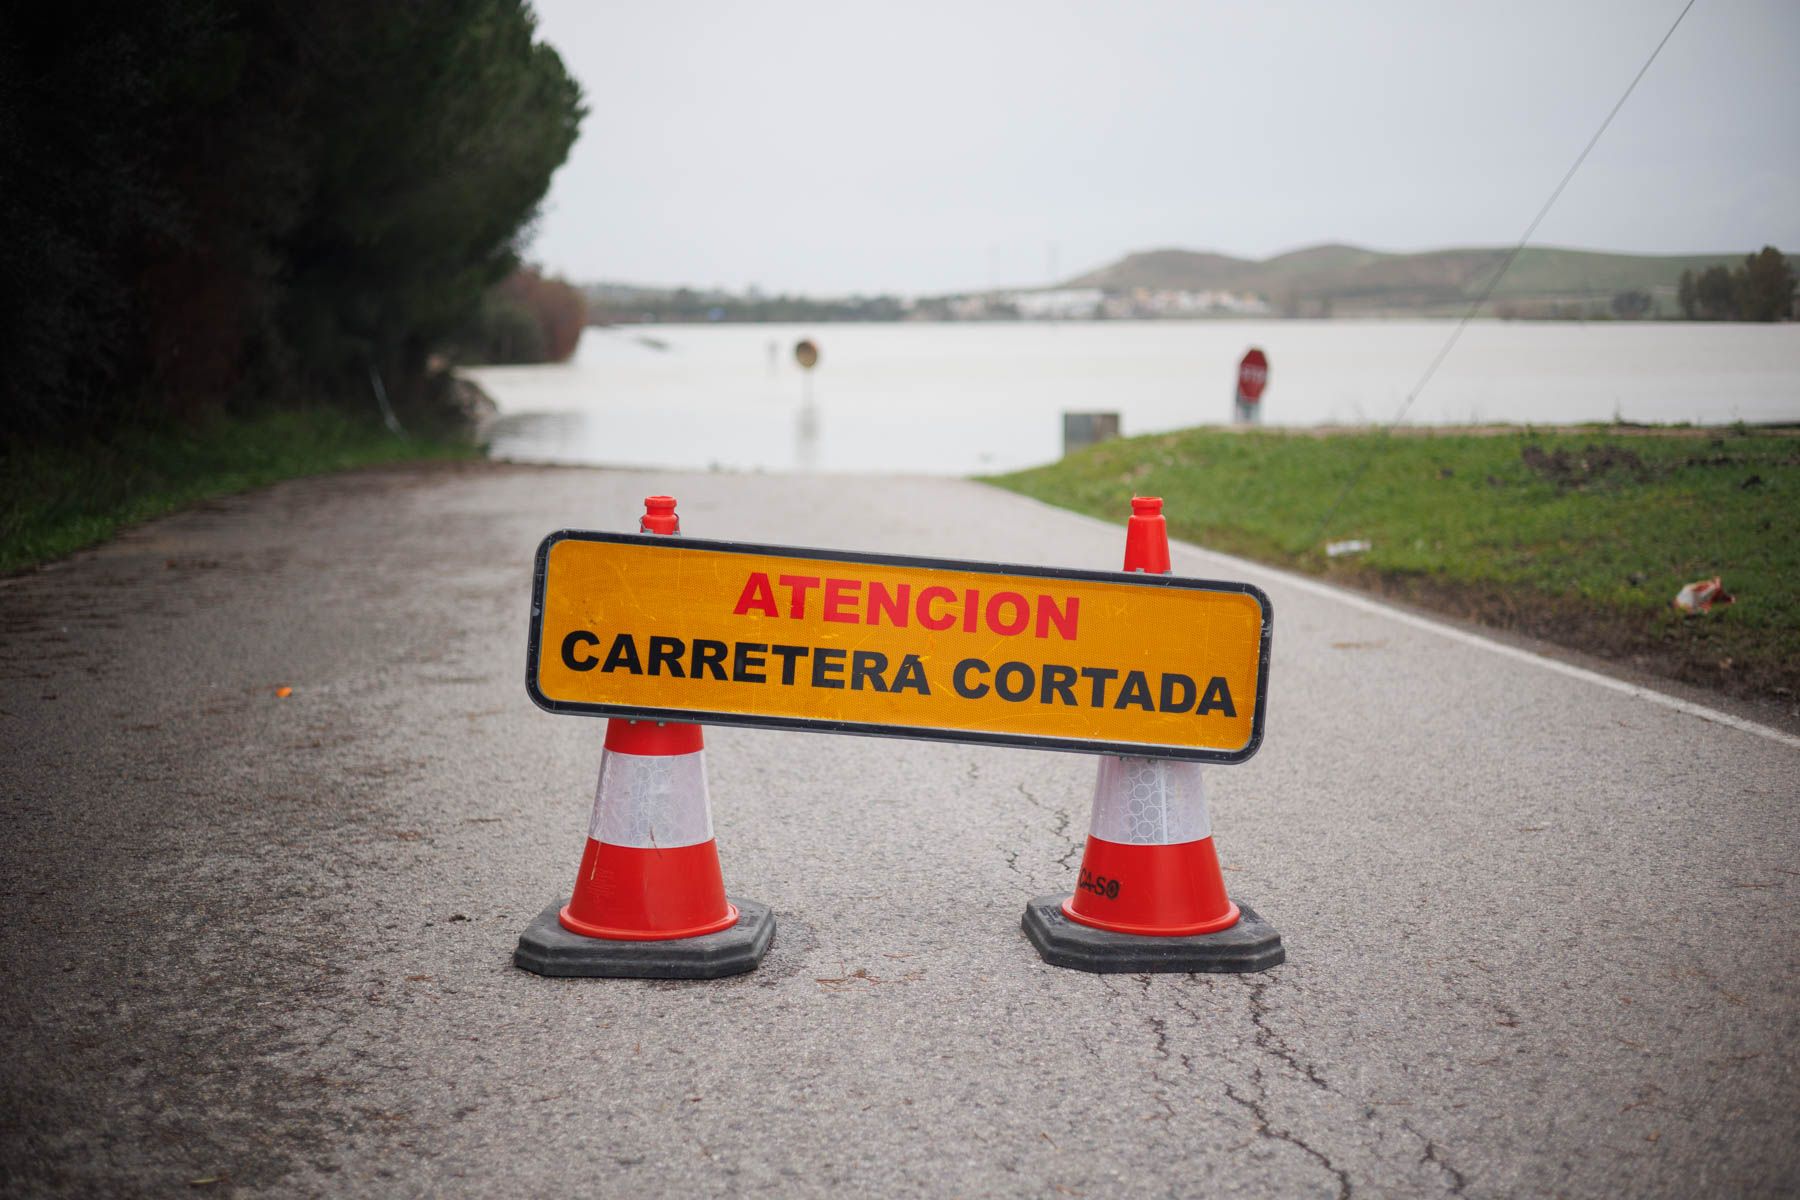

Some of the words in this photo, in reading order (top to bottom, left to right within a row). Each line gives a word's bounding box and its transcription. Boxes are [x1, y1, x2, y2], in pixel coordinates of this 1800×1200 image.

[733, 571, 1080, 641] ATENCION
[560, 630, 931, 695] CARRETERA
[953, 658, 1237, 718] CORTADA
